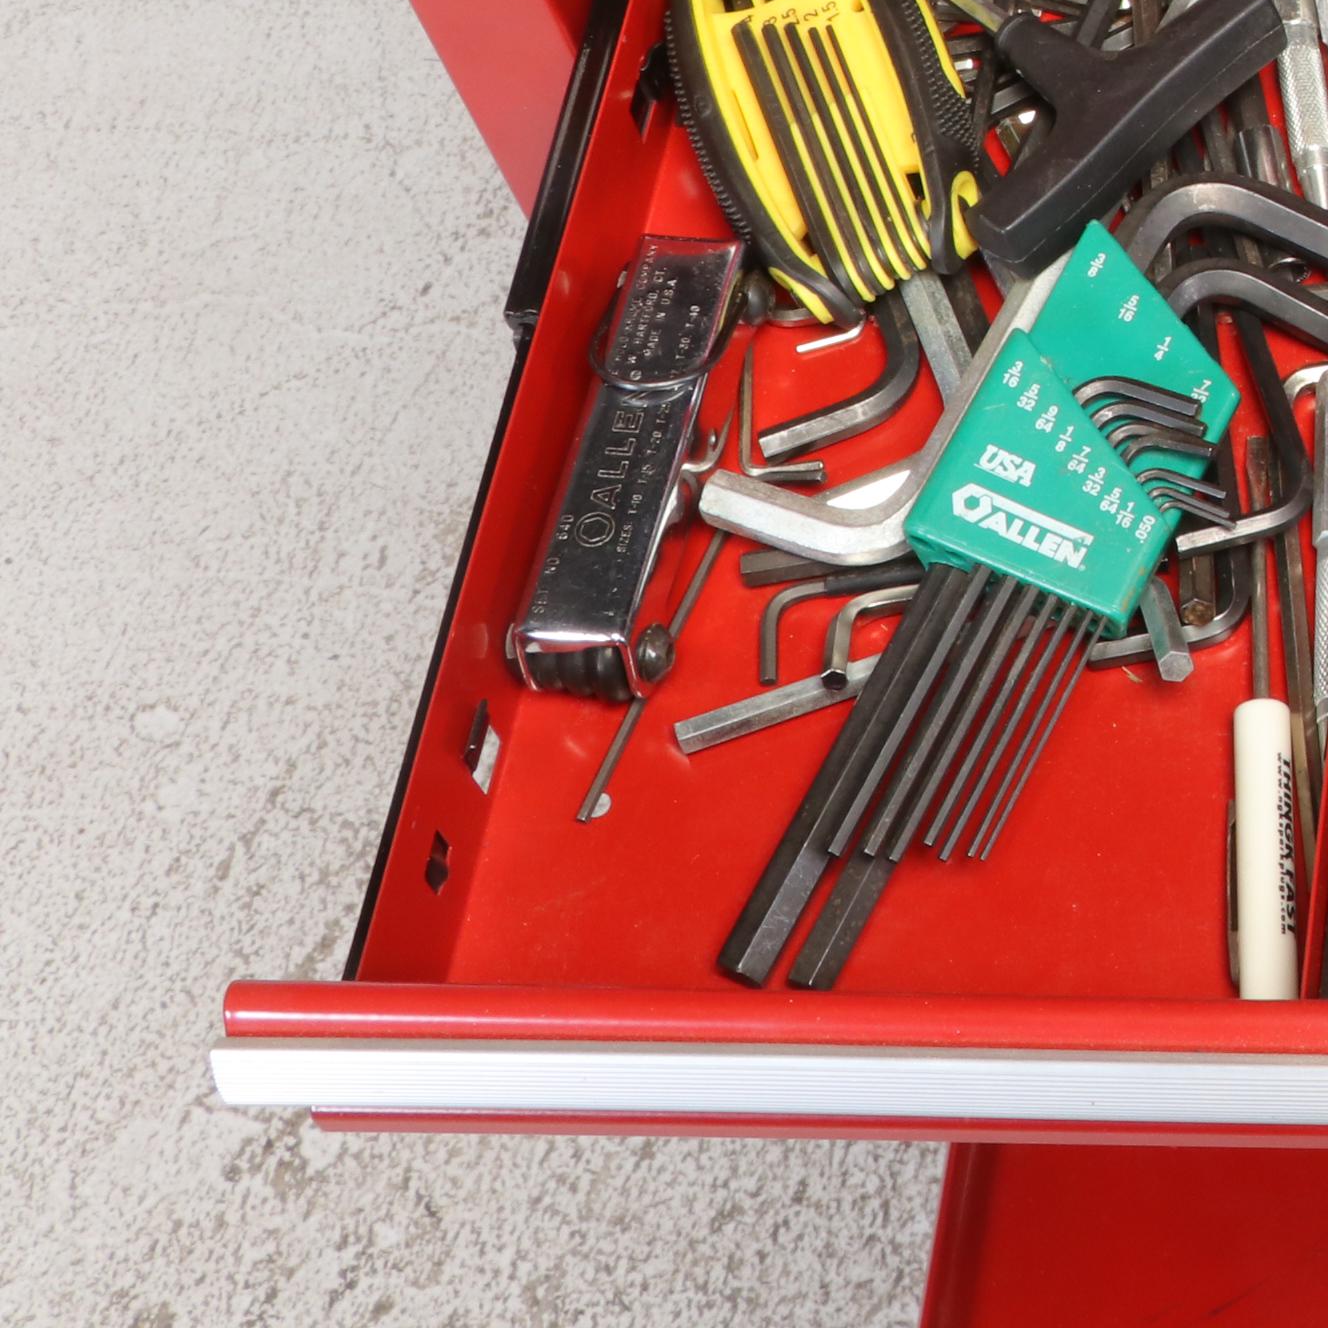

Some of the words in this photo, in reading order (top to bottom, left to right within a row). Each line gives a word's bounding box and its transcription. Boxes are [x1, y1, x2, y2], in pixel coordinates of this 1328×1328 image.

[588, 382, 651, 510] ALLEN
[976, 443, 1037, 486] USA
[978, 505, 1088, 570] ALLEN
